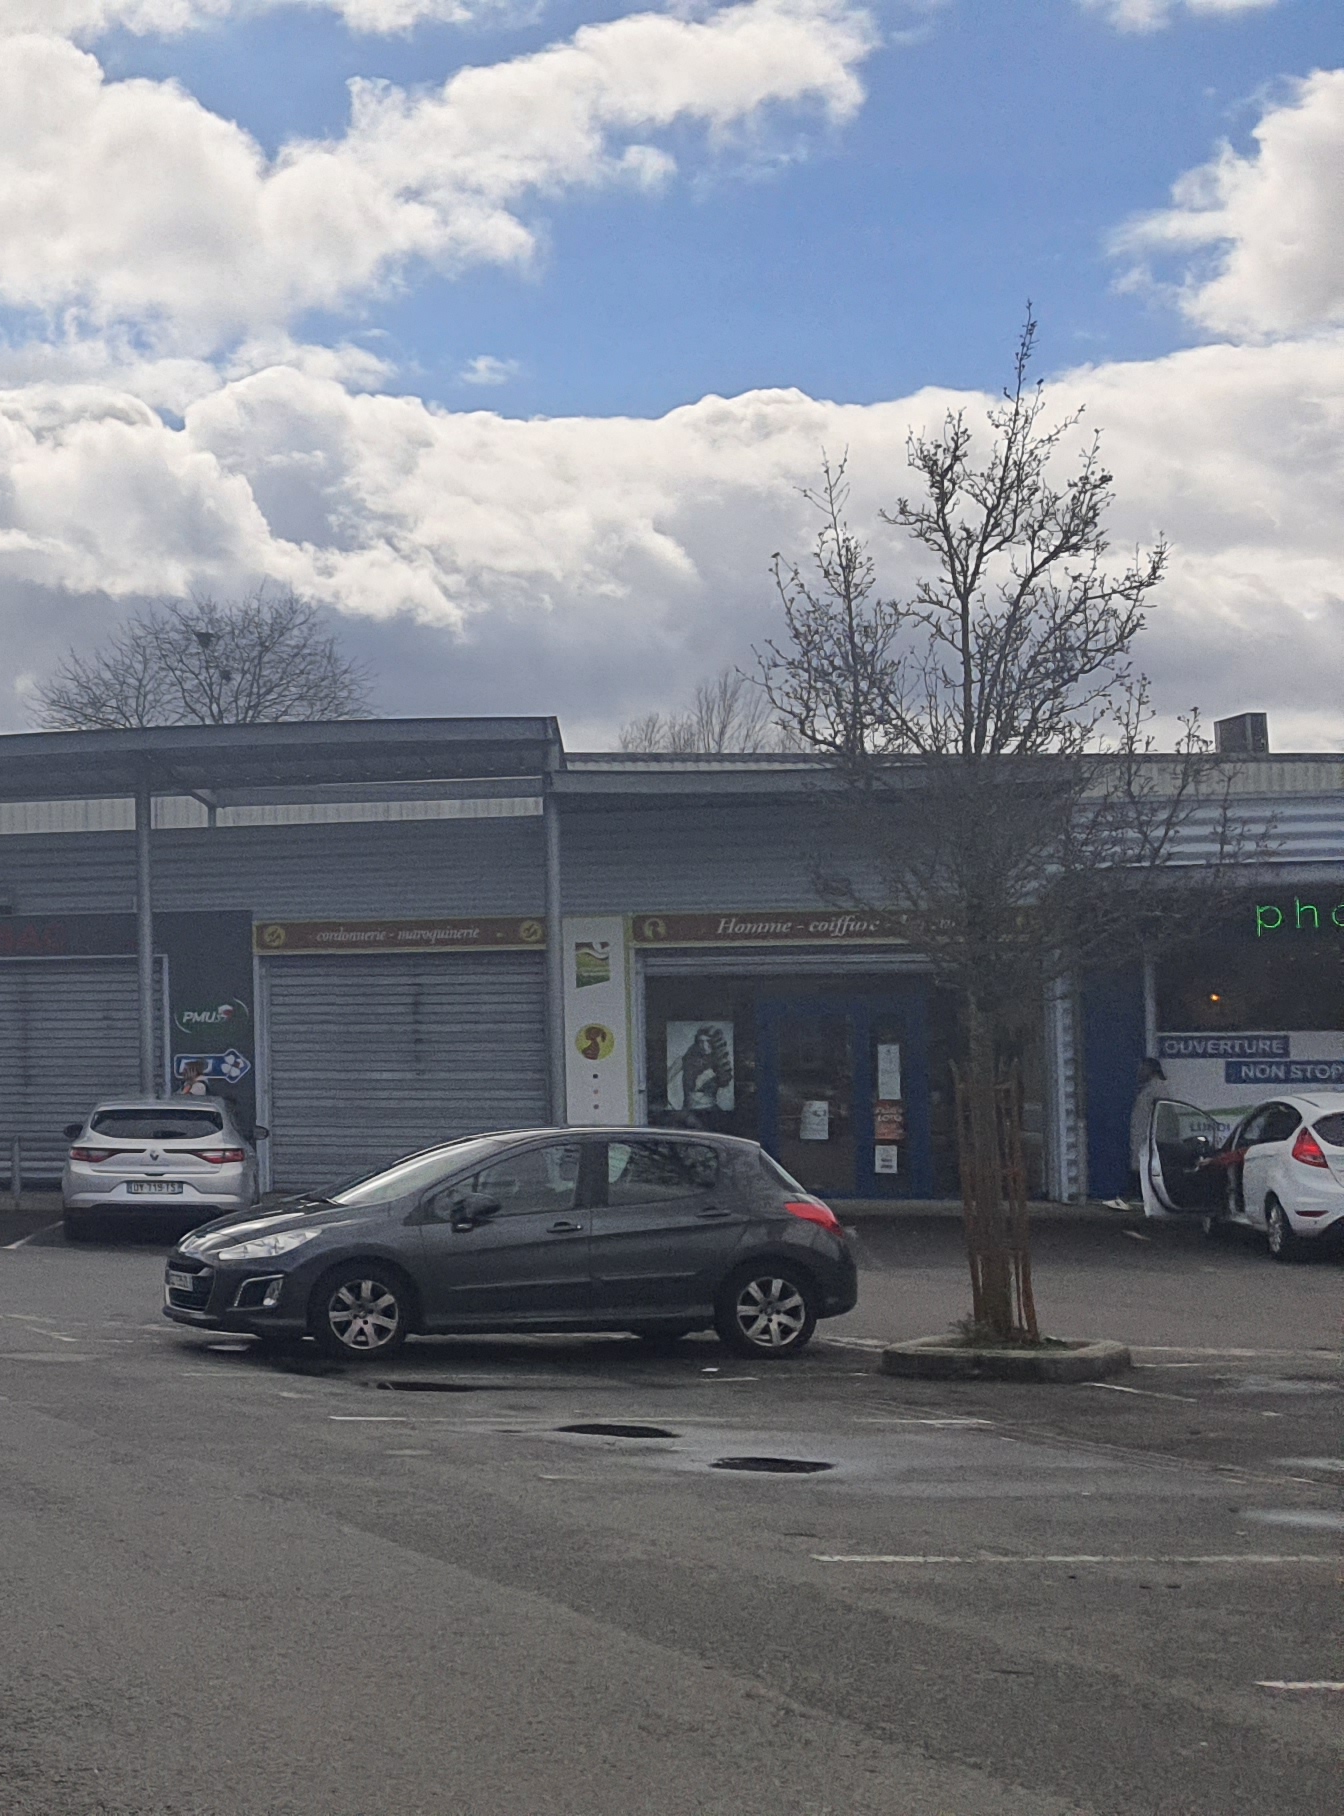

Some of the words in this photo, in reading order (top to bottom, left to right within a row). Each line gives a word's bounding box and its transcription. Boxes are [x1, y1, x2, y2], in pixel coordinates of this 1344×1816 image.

[716, 917, 791, 934] Homme
[316, 927, 386, 942] cordonnerie
[398, 926, 480, 943] maroquinerie
[182, 1011, 216, 1023] PMU
[1165, 1039, 1285, 1054] OUVERTURE
[1241, 1064, 1286, 1079] NON
[1289, 1064, 1344, 1079] STOP
